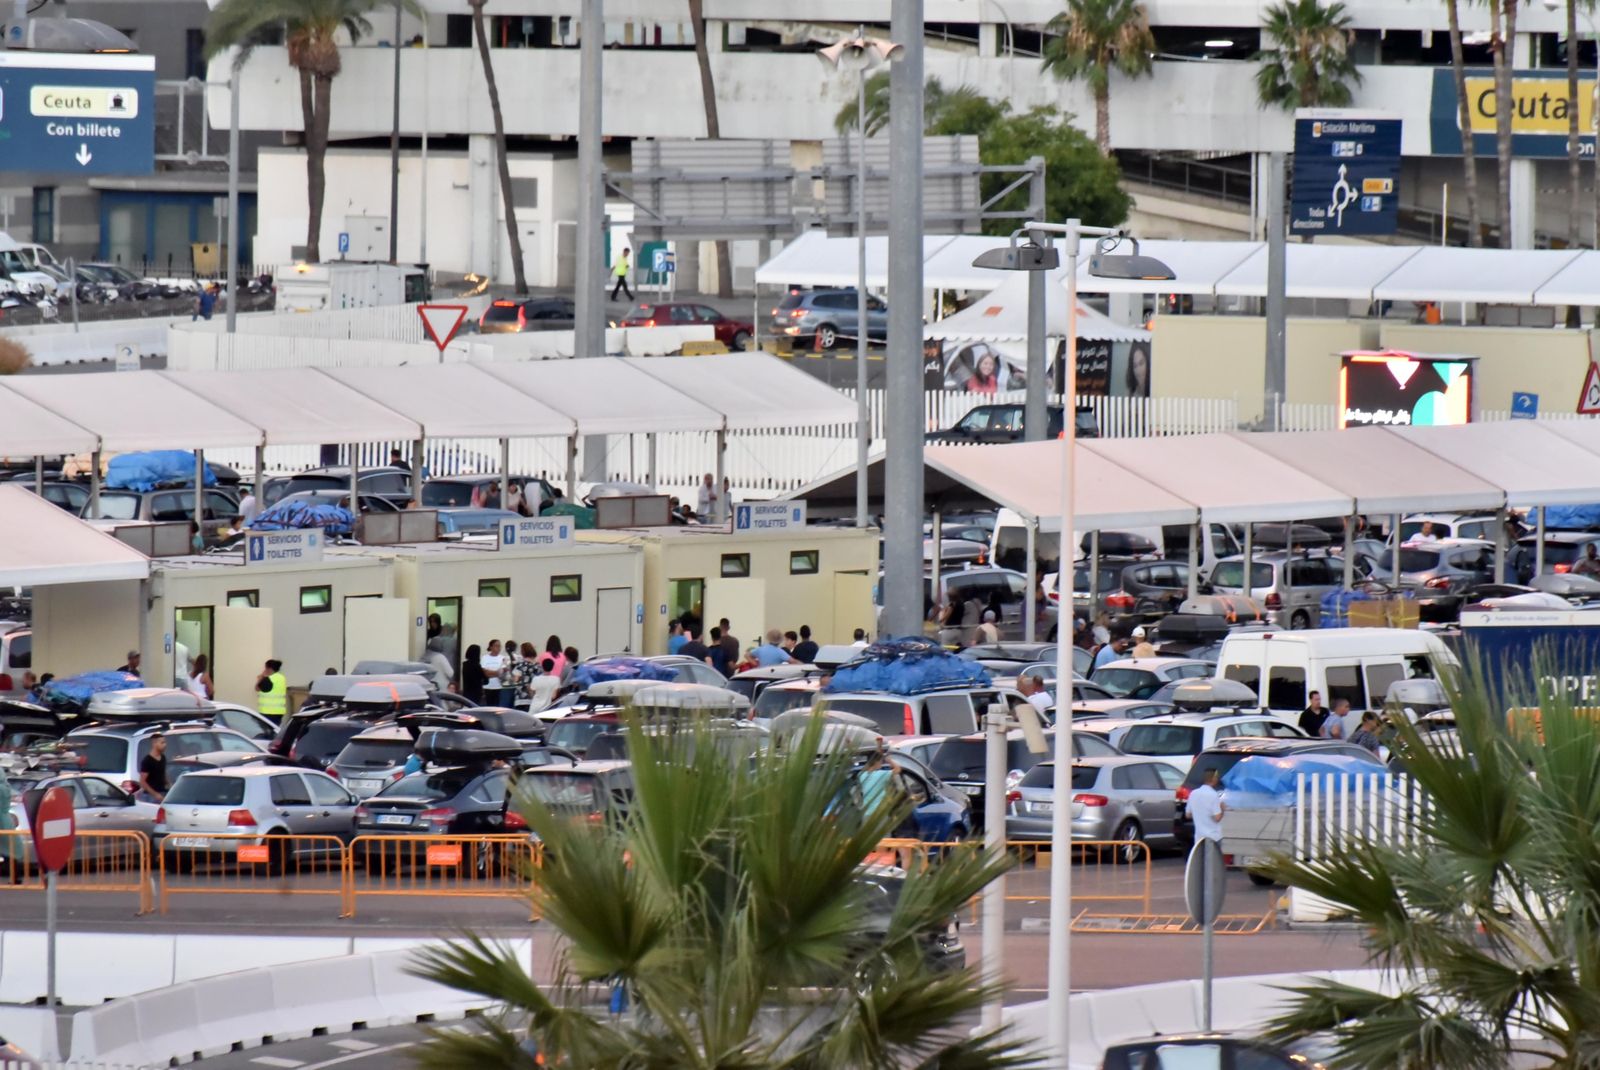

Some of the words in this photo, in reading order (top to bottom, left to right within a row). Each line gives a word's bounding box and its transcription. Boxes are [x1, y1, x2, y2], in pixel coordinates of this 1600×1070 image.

[43, 94, 92, 109] Ceuta
[1477, 88, 1569, 119] Cuta
[46, 122, 74, 136] Con
[77, 123, 121, 138] billete
[755, 505, 788, 514] SERVICIOS
[520, 522, 554, 531] SERVICIOS
[754, 519, 788, 528] TOILETTES
[267, 535, 302, 545] SERVICIOS
[520, 535, 554, 544] TOILETTES
[267, 549, 303, 559] TOILETTES
